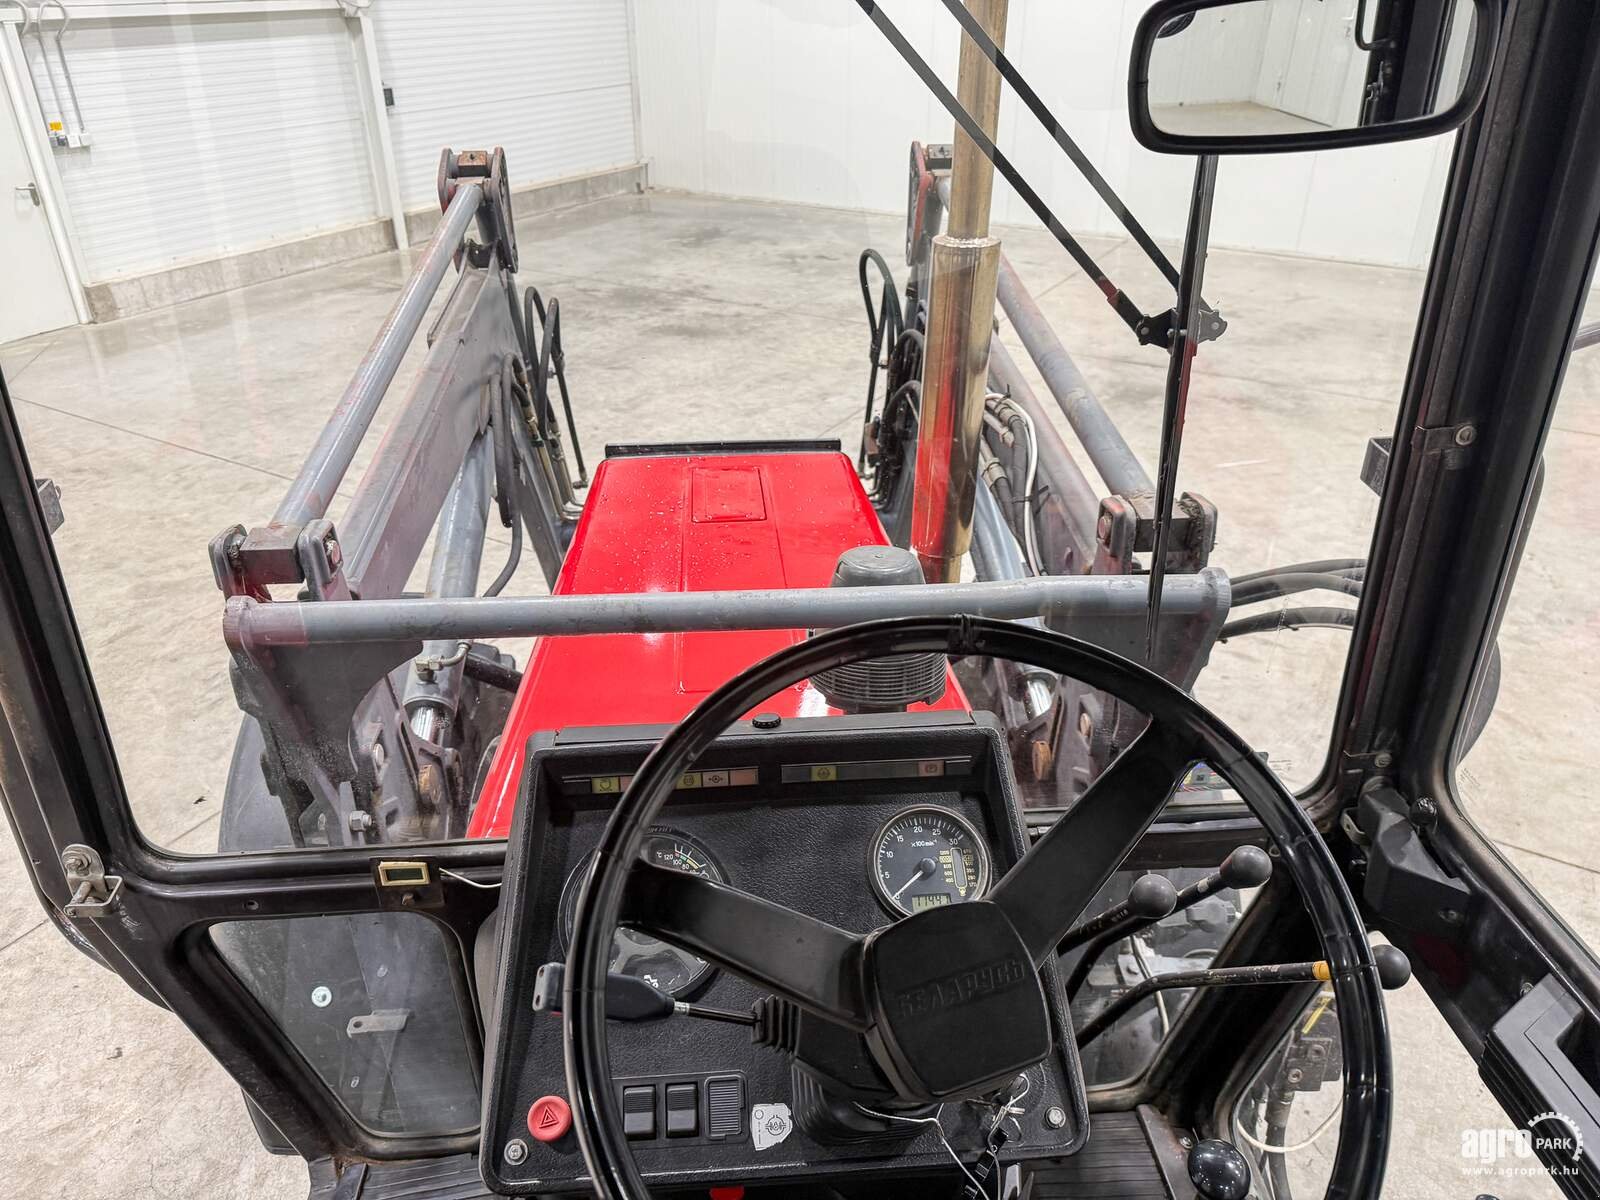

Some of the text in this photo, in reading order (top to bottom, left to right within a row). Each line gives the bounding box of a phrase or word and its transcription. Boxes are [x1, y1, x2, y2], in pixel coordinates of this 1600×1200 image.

[932, 828, 941, 836] 25
[896, 835, 904, 843] 15
[884, 871, 890, 879] 5
